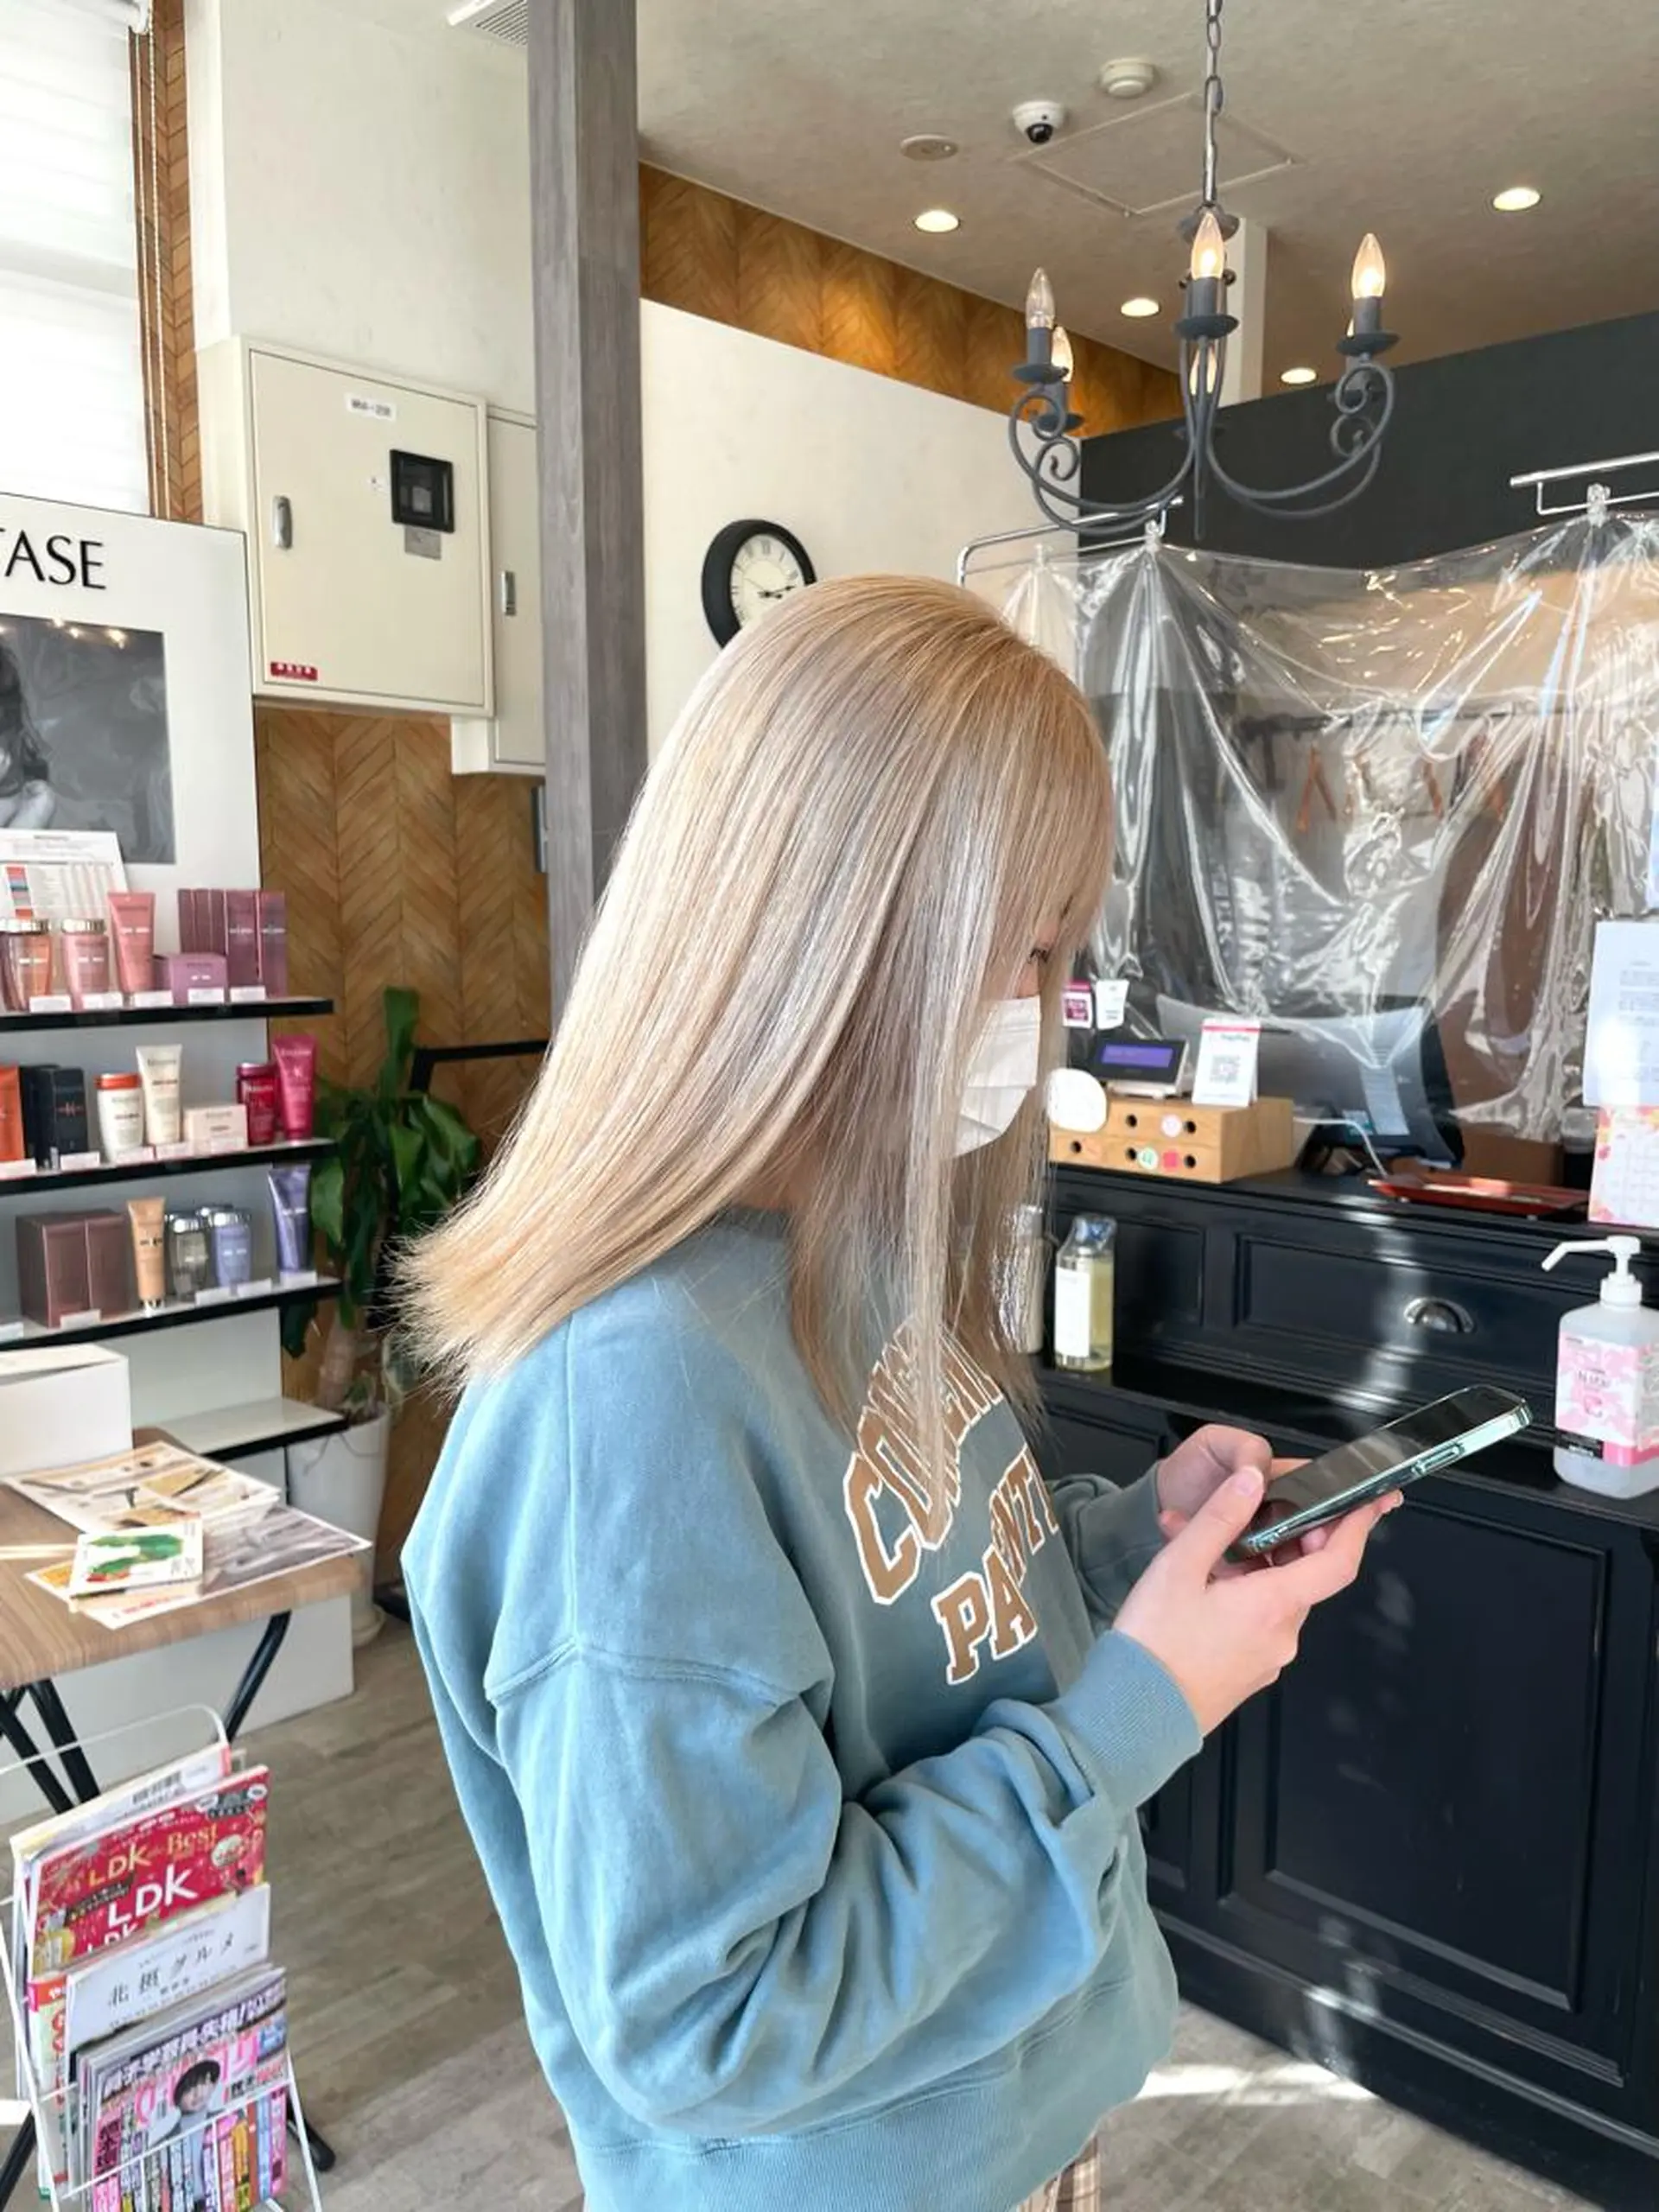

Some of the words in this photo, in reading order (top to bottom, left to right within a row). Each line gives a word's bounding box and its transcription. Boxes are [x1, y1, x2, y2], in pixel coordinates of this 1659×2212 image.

[0, 526, 107, 590] ASE
[88, 1842, 151, 1887] LDK
[108, 1863, 199, 1929] LDK
